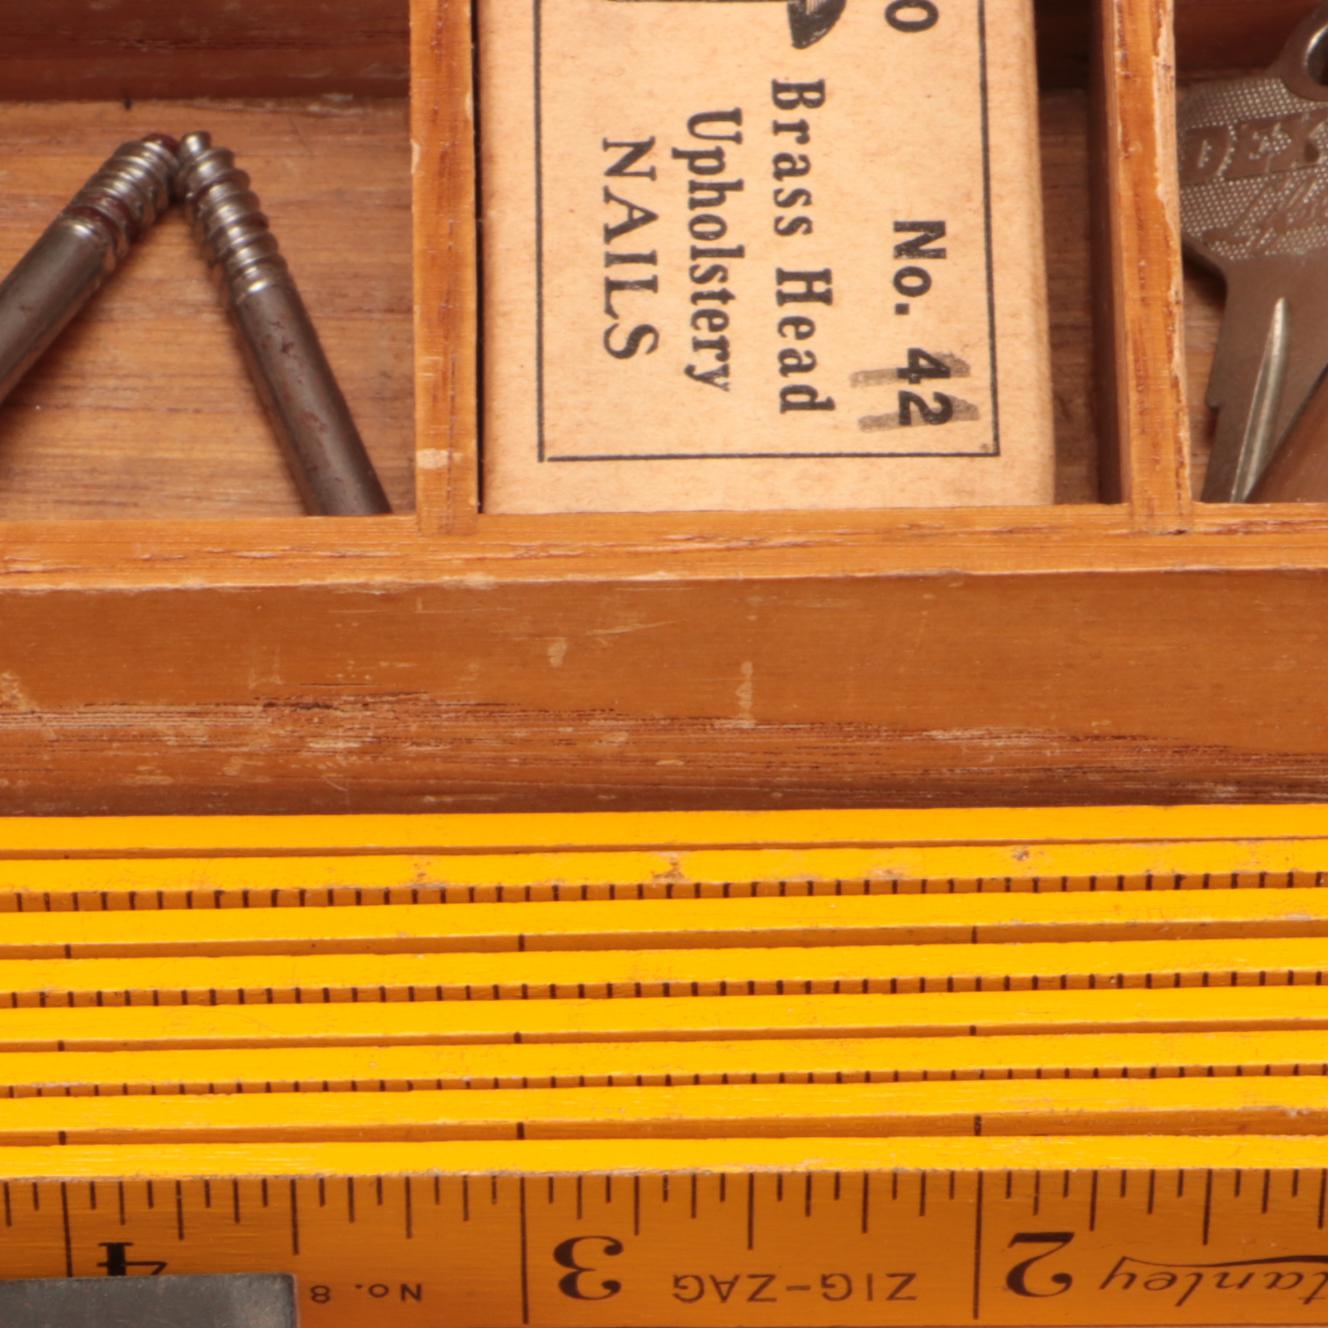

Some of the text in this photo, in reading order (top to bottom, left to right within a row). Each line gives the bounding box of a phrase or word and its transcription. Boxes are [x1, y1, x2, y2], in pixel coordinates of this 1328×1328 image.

[602, 136, 660, 360] NAILS
[671, 107, 746, 392] Upholstery
[771, 78, 837, 415] Brass Head
[892, 219, 954, 428] No. 42
[310, 1282, 423, 1304] No. 8
[552, 1235, 625, 1301] 3
[672, 1271, 918, 1304] ZIG-ZAG
[1004, 1230, 1076, 1298] 2
